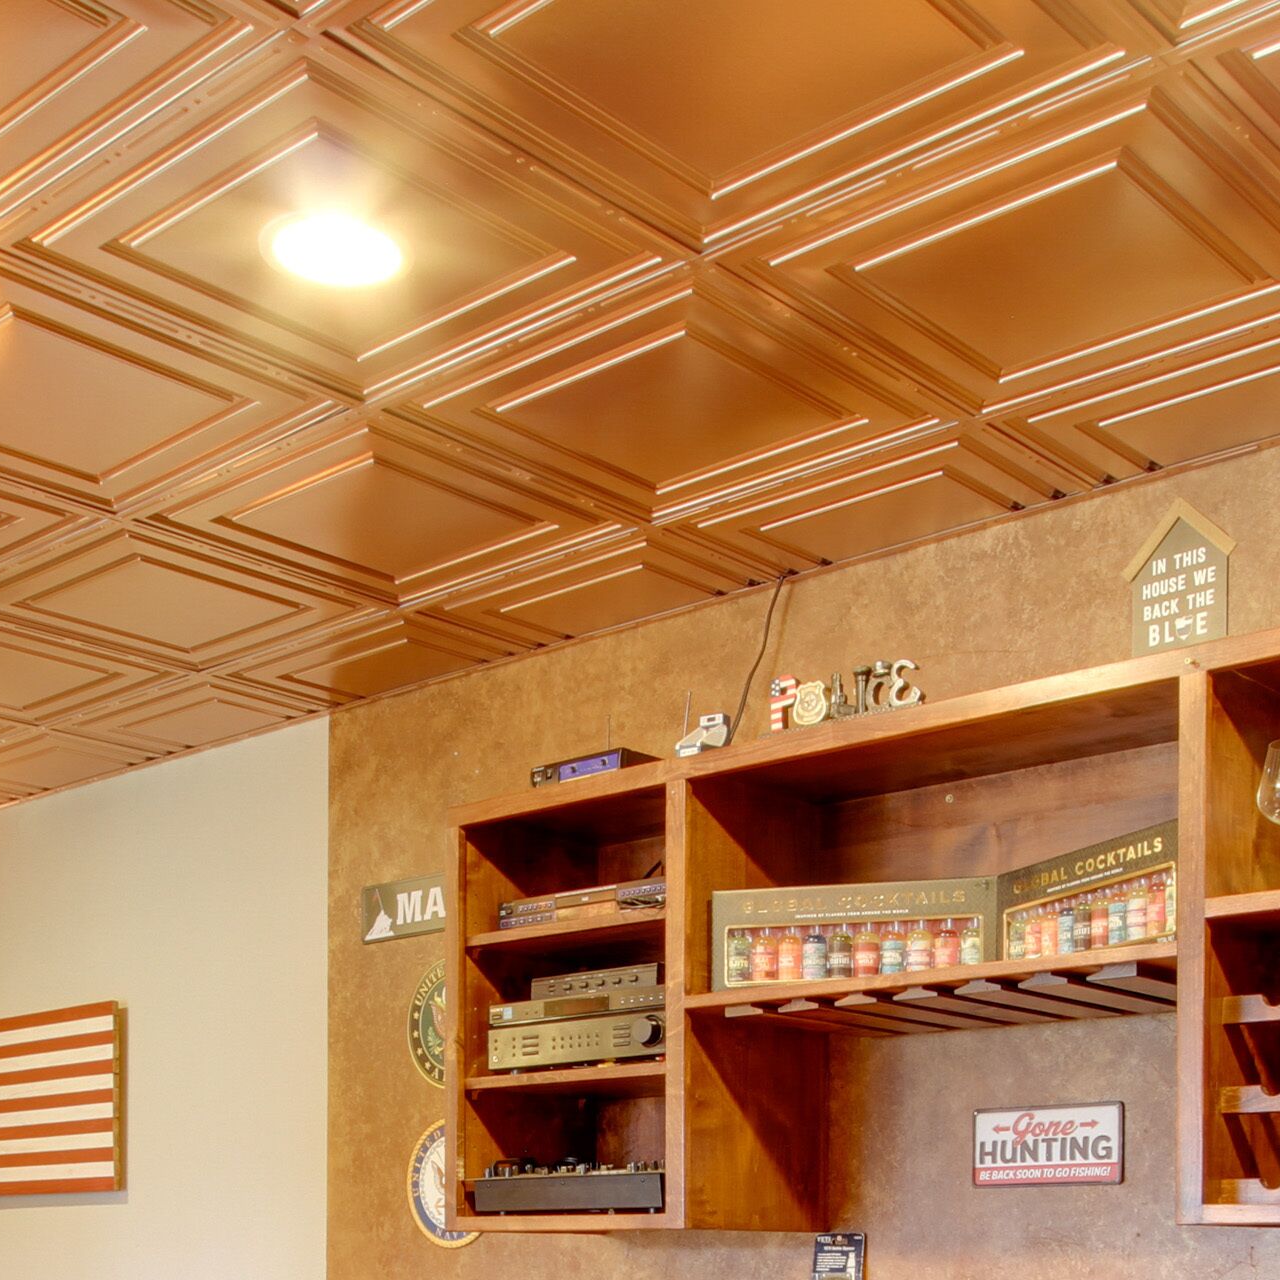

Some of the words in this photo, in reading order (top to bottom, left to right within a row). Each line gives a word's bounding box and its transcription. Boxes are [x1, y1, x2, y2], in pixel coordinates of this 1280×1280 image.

[1151, 558, 1167, 576] IN
[1173, 547, 1207, 570] THIS
[1142, 574, 1187, 601] HOUSE
[1193, 566, 1217, 586] WE
[1143, 598, 1180, 622] BACK
[1186, 588, 1216, 610] THE
[1075, 837, 1163, 876] COCKTAILS
[1011, 1112, 1079, 1147] Gone
[978, 1134, 1114, 1166] HUNTING
[979, 1170, 991, 1181] BE
[991, 1169, 1015, 1181] BACK
[1016, 1168, 1041, 1179] SOON
[1042, 1168, 1055, 1178] TO
[1055, 1166, 1070, 1178] GO
[1070, 1165, 1111, 1177] FISHING!
